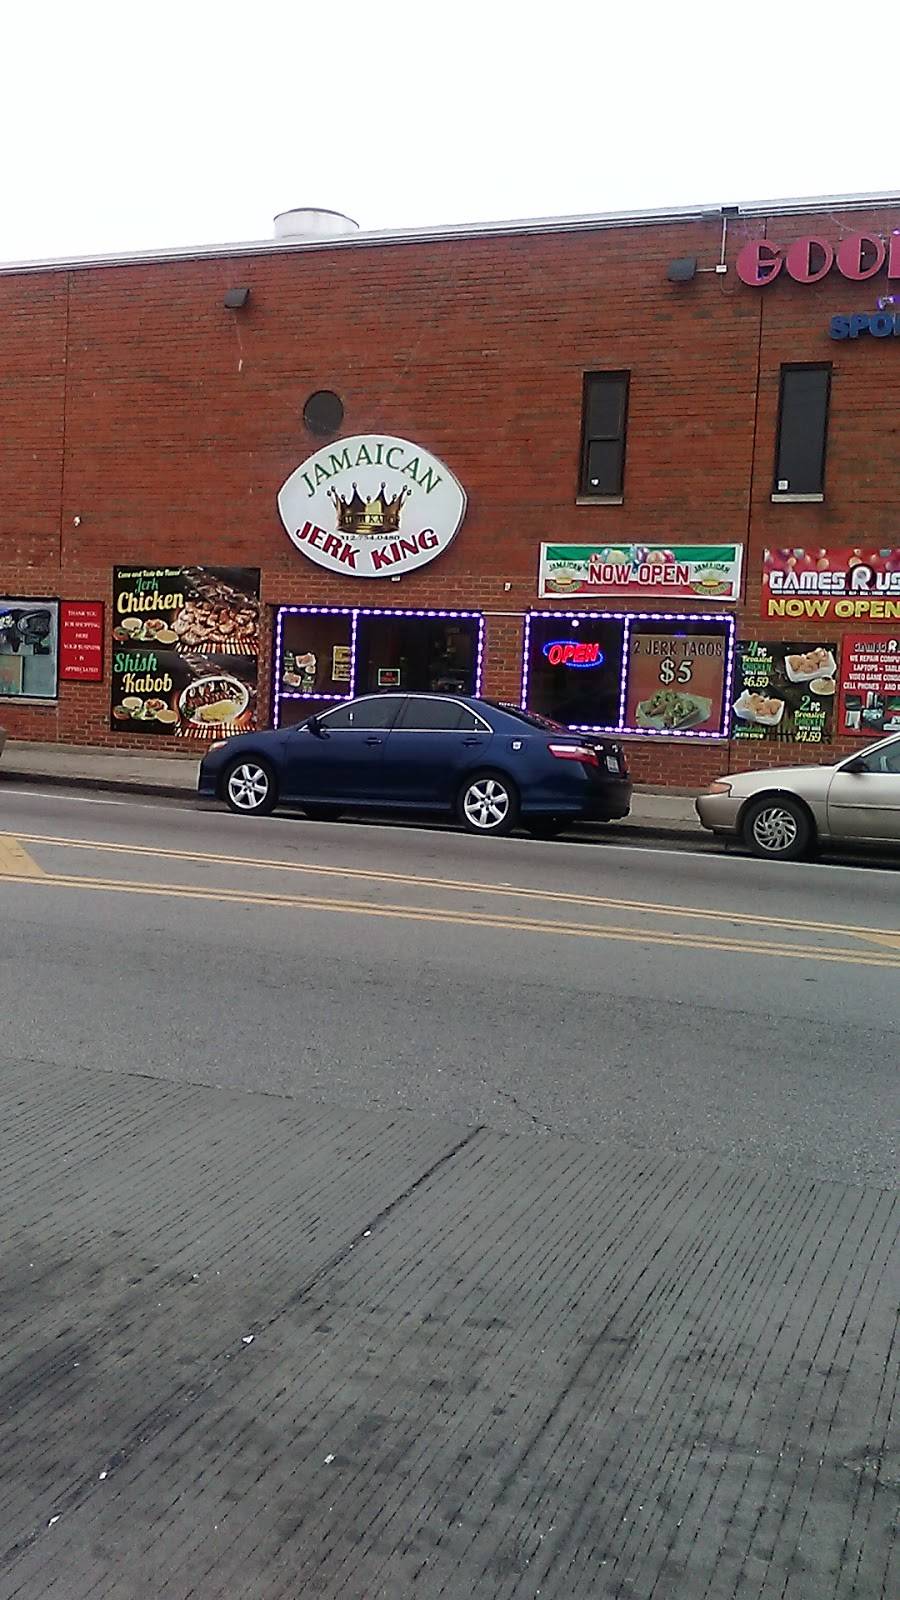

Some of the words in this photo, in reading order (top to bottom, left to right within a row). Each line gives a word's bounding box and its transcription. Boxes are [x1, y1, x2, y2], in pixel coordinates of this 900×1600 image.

[736, 233, 900, 286] GOO
[301, 443, 443, 498] JAMAICAN
[295, 521, 361, 569] JERK
[371, 528, 440, 571] KING
[588, 563, 632, 585] NOW
[637, 563, 690, 586] OPEN
[769, 570, 846, 590] GAMES
[851, 565, 873, 590] R
[135, 577, 159, 594] Jerk
[117, 590, 184, 614] Chicken
[767, 599, 831, 618] NOW
[835, 600, 900, 619] OPEN
[548, 643, 600, 665] OPEN
[633, 640, 641, 654] 2
[645, 640, 678, 656] JERK
[682, 640, 723, 657] TACOS
[747, 640, 758, 656] 4
[757, 647, 767, 657] PC
[114, 652, 157, 673] Shish
[659, 656, 693, 685] $5
[853, 664, 878, 672] LAPTOPS
[122, 673, 173, 693] Kabob
[843, 682, 856, 690] CELL
[857, 682, 879, 690] PHONES
[866, 673, 882, 681] GAME
[800, 695, 811, 711] 2
[811, 702, 821, 712] PC
